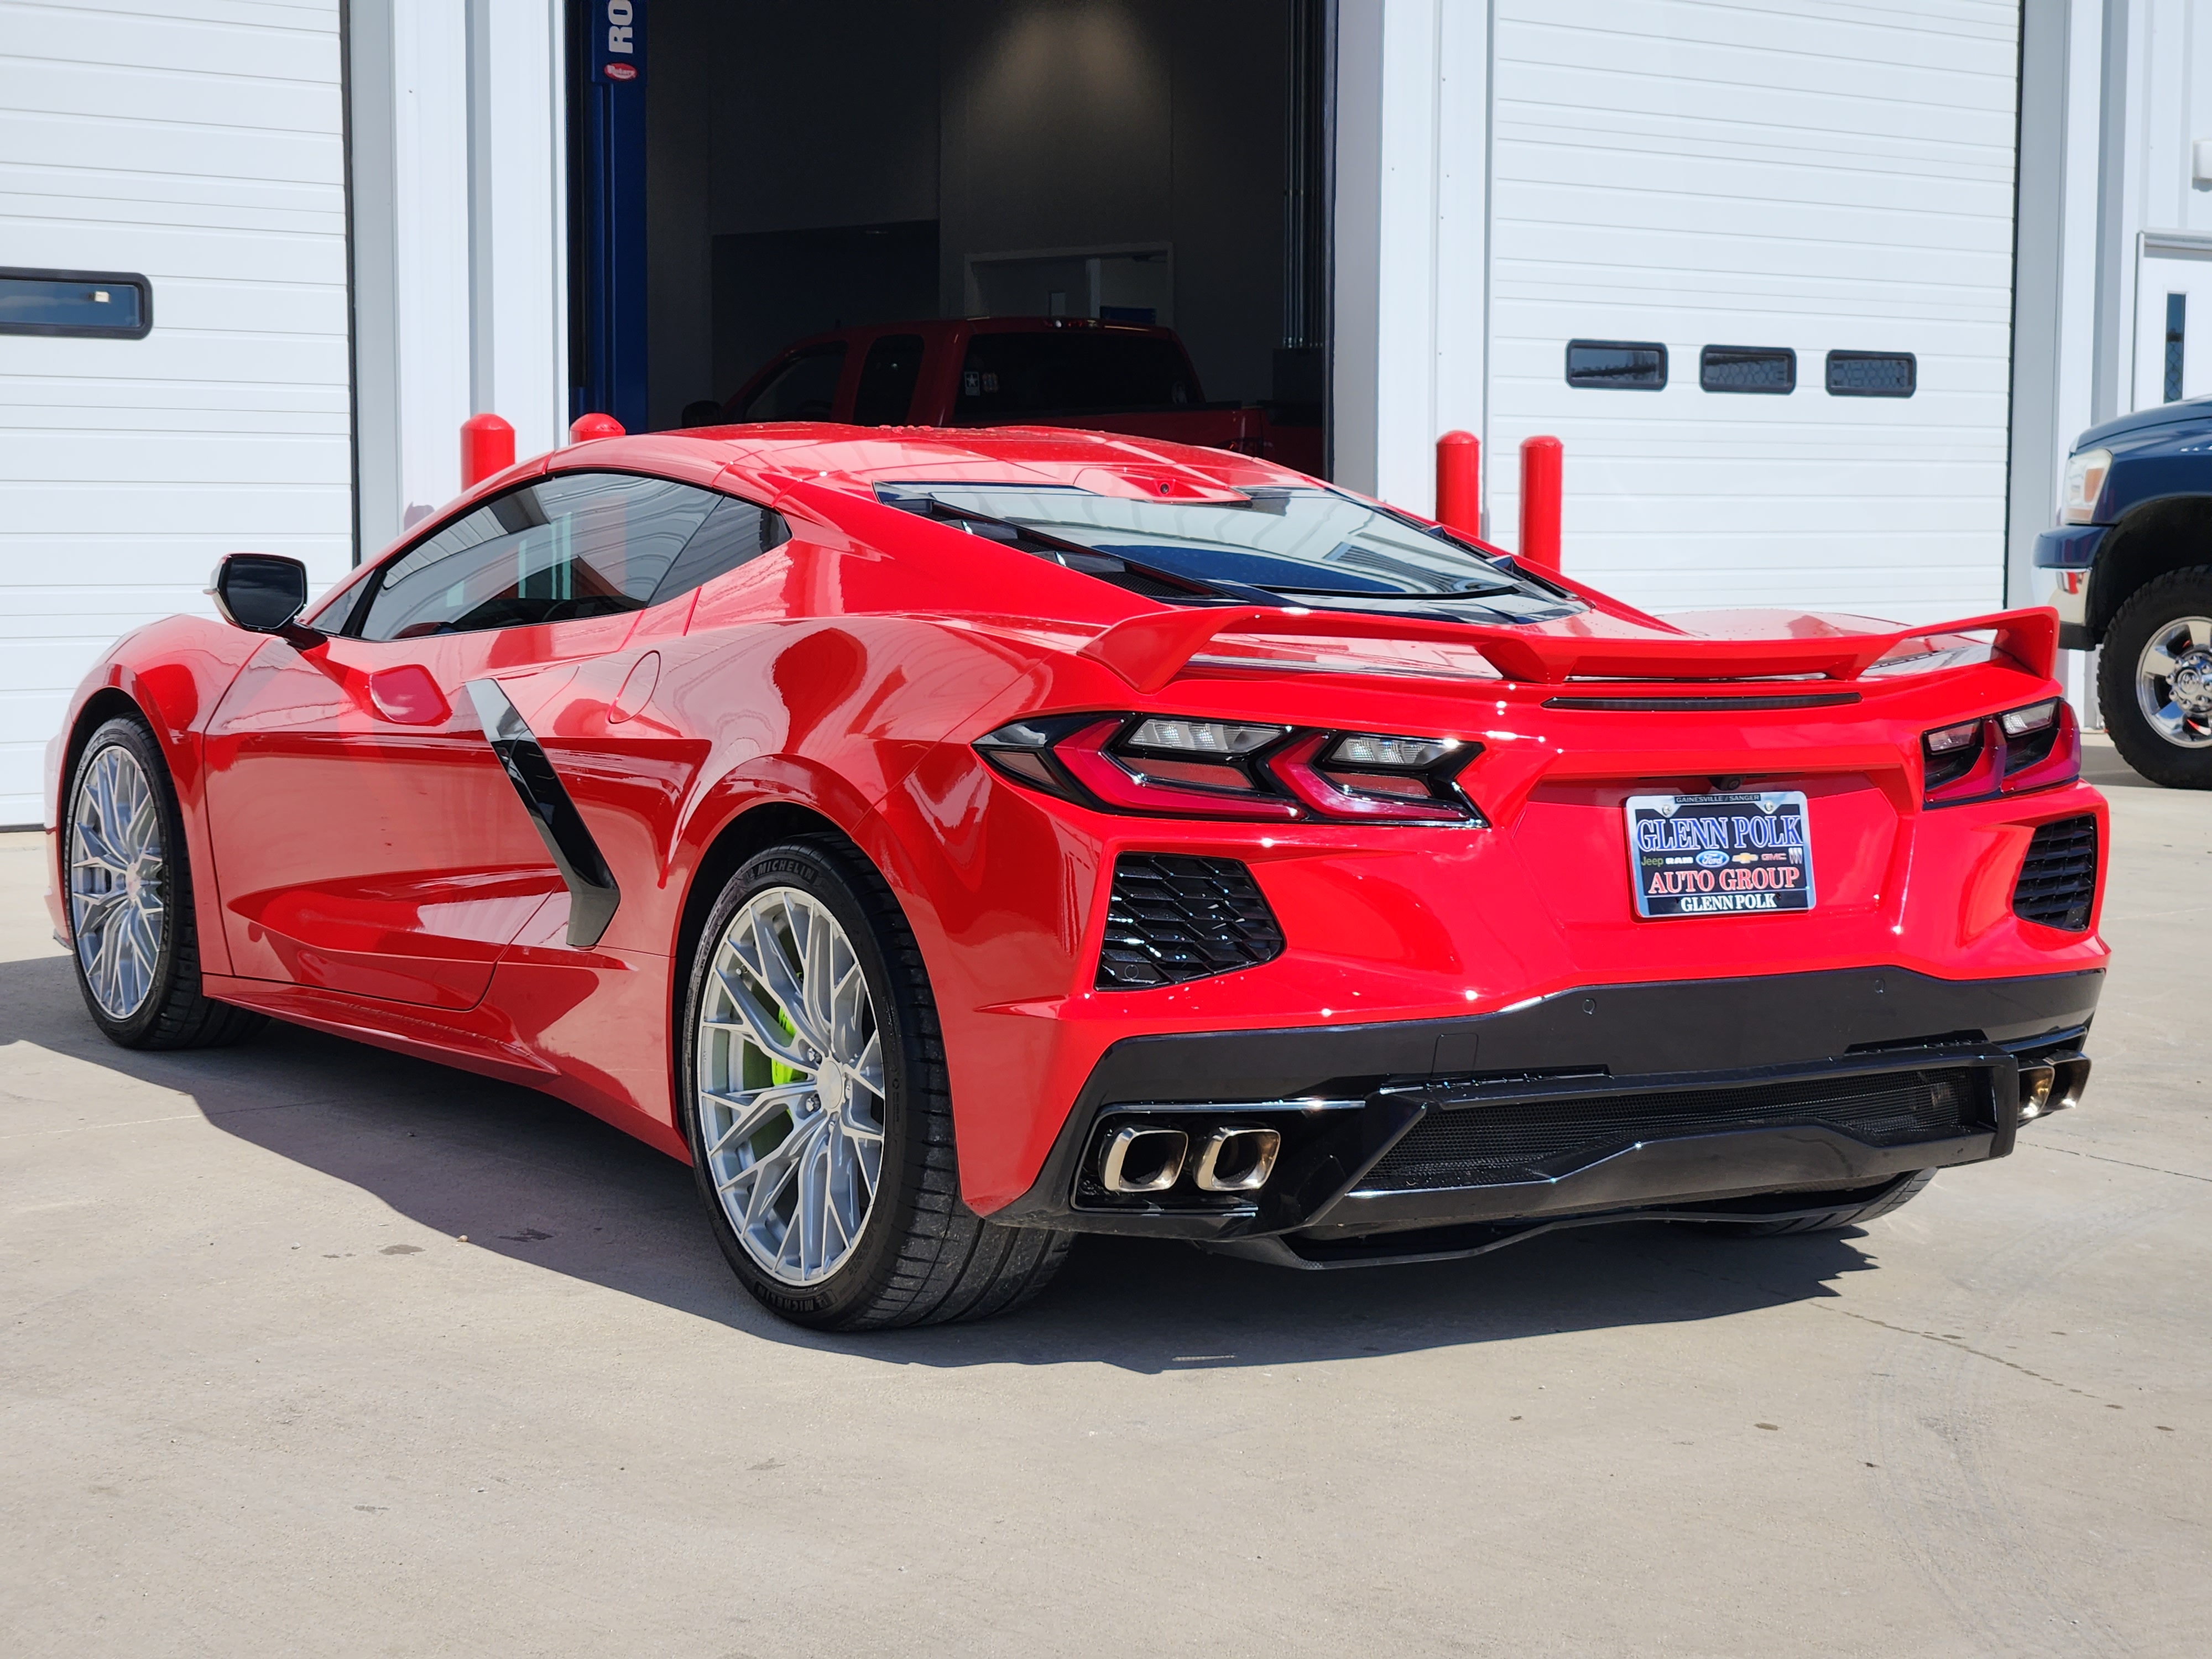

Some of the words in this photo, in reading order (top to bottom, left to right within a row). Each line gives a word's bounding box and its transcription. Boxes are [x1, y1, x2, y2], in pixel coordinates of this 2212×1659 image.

[1637, 817, 1729, 852] GLENN
[1733, 815, 1803, 847] POLK
[758, 860, 815, 880] MICHELIN
[1641, 856, 1663, 867] Jeep
[1701, 853, 1723, 865] Ford
[1648, 870, 1714, 893] AUTO
[1719, 867, 1799, 890] GROUP
[1681, 895, 1735, 912] GLENN
[1735, 893, 1777, 909] POLK
[756, 1284, 814, 1311] MICHELIN
